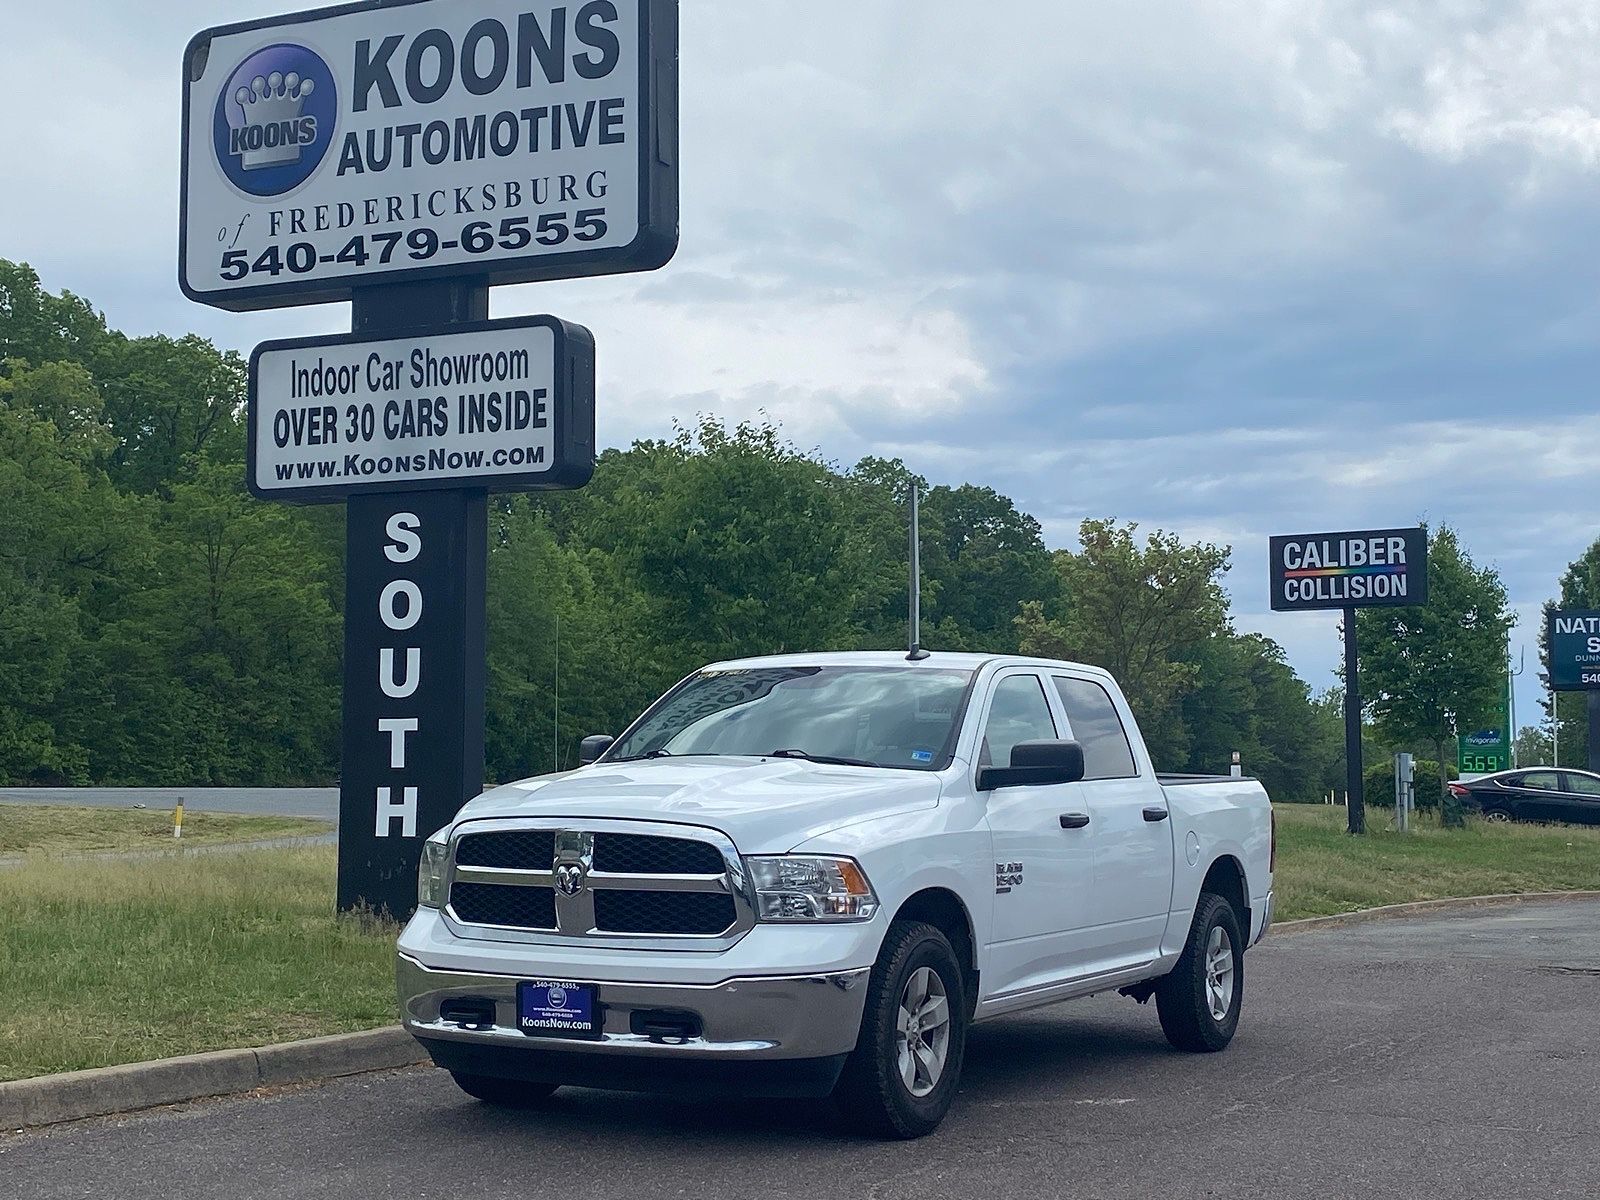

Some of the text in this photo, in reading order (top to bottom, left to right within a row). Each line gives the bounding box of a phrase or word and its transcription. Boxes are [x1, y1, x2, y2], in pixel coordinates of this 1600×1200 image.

[352, 0, 620, 113] KOONS
[231, 117, 317, 153] KOONS
[336, 97, 626, 177] AUTOMOTIVE
[217, 170, 609, 249] of FREDERICKSBURG
[219, 208, 609, 281] 540-479-6555
[291, 348, 529, 399] Indoor Car Showroom
[273, 388, 547, 449] OVER 30 CARS INSIDE
[1283, 536, 1406, 570] CALIBER
[1284, 574, 1407, 602] COLLISION
[375, 511, 423, 837] SOUTH
[522, 1017, 592, 1030] KoonsNow.com
